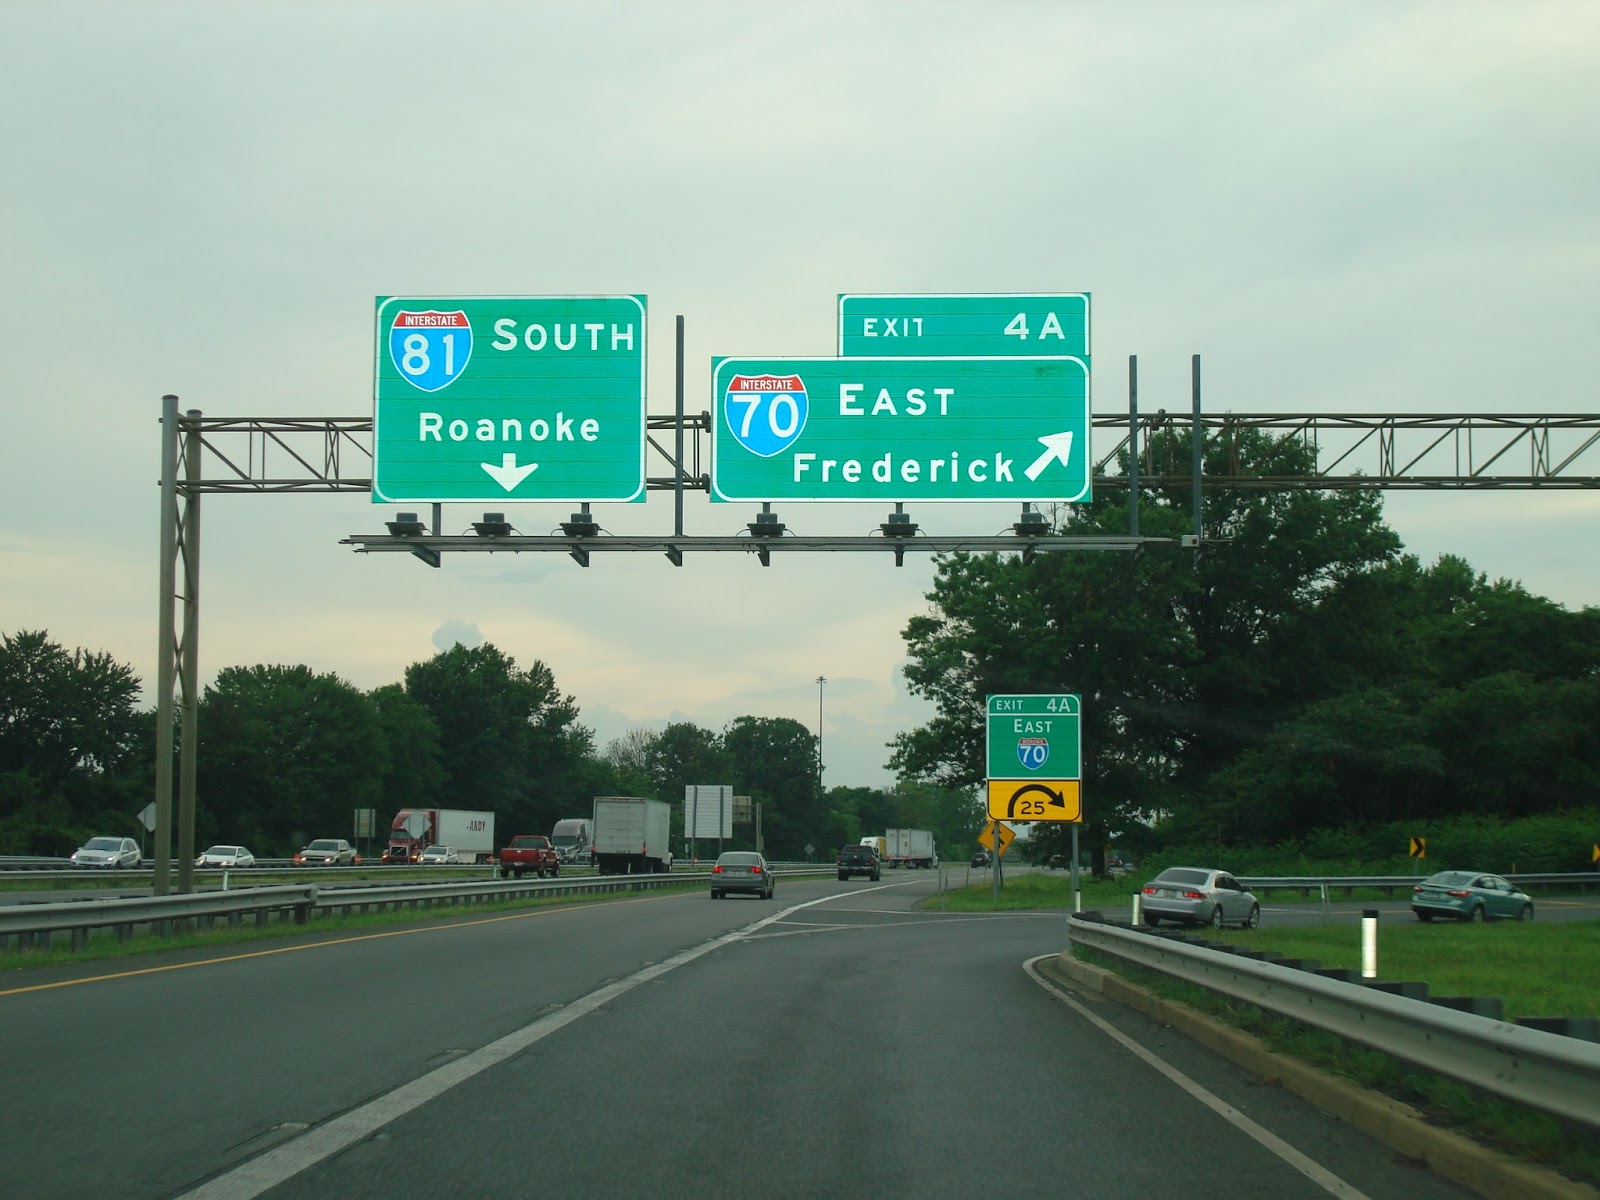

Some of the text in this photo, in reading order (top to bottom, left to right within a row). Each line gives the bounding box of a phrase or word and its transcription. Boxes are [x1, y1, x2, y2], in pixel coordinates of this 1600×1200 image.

[404, 315, 458, 326] INTERSTATE
[490, 318, 634, 351] SOUTH
[863, 312, 1066, 340] EXIT 4A
[402, 333, 455, 376] 81
[740, 379, 793, 391] INTERSTATE
[839, 383, 955, 416] EAST
[419, 411, 600, 442] Roanoke
[732, 394, 799, 438] 70
[793, 451, 1014, 483] Frederick
[996, 697, 1071, 713] EXIT 4A
[1014, 718, 1053, 733] EAST
[1019, 745, 1046, 763] 70
[1020, 801, 1045, 815] 25
